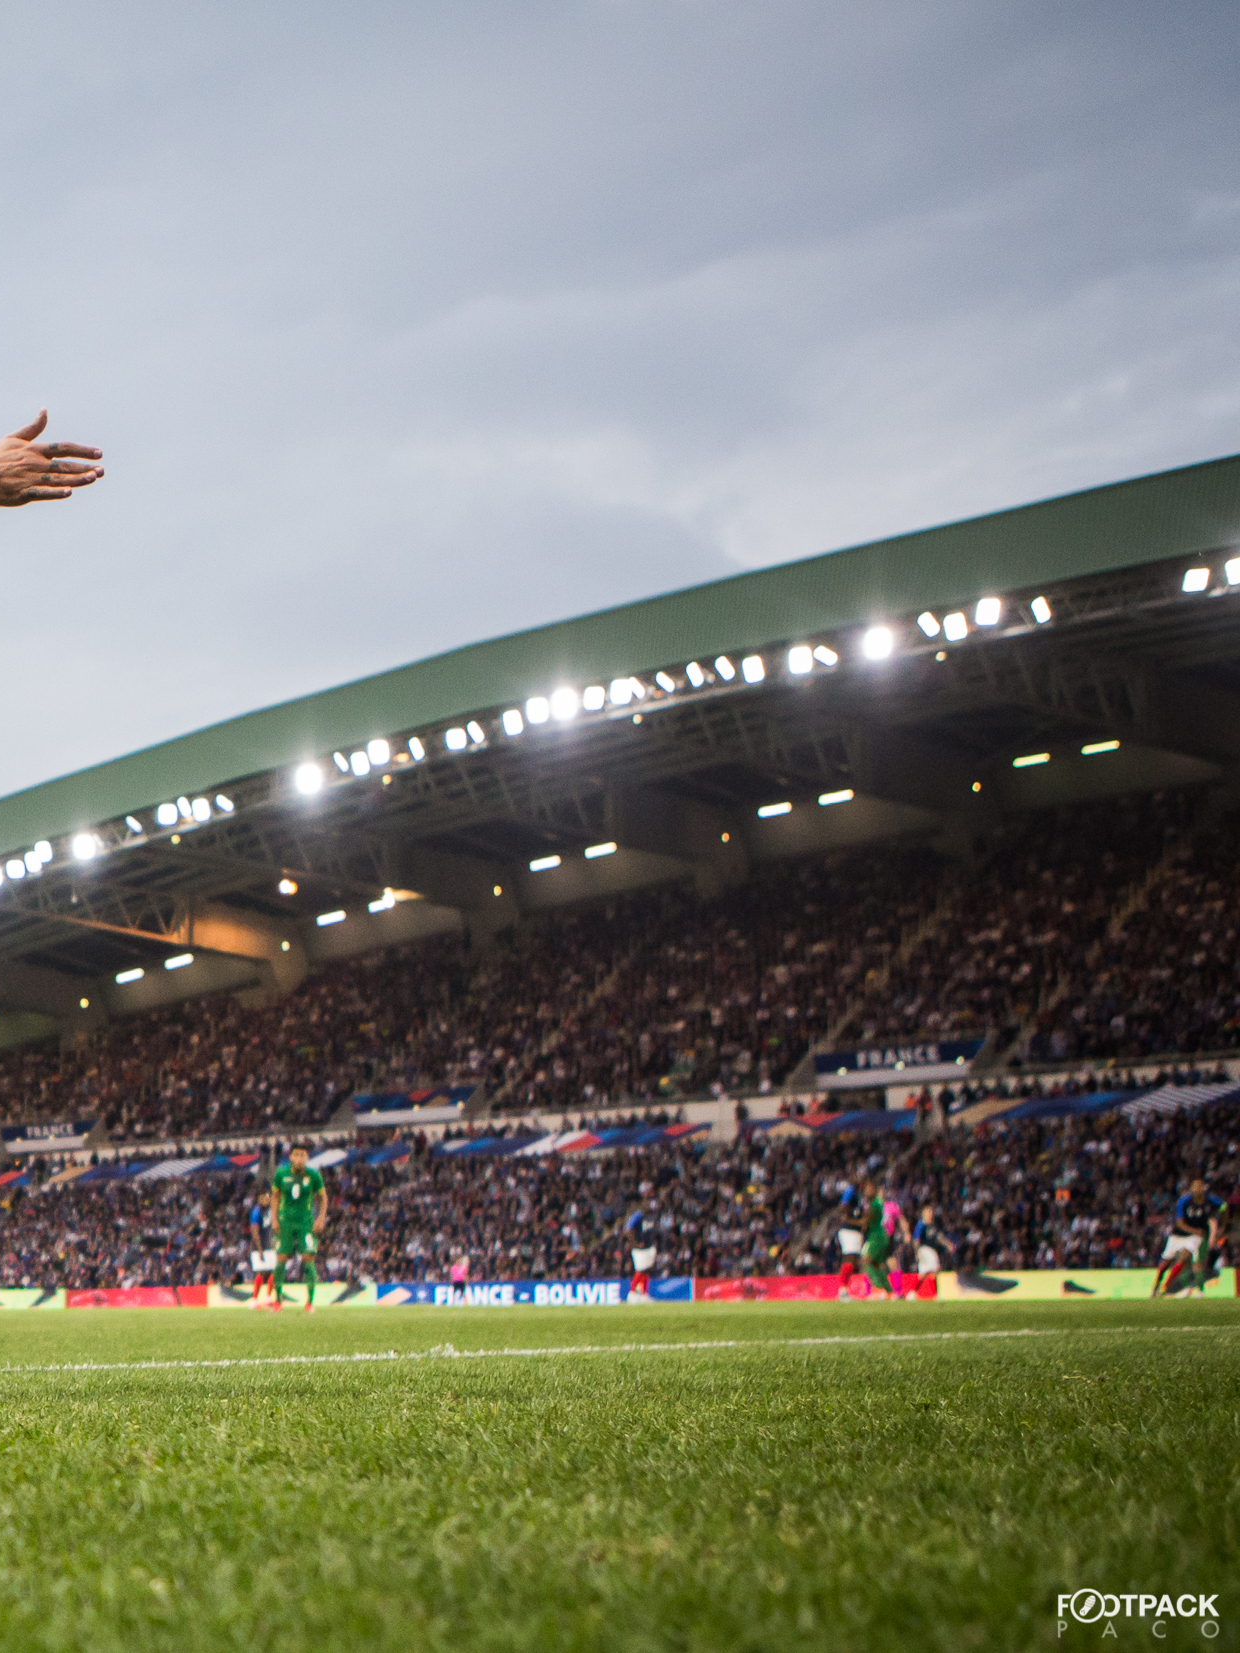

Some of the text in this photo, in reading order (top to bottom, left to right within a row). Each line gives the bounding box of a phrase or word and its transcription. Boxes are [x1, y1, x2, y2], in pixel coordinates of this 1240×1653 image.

[856, 1045, 939, 1069] FRANCE
[26, 1123, 74, 1138] FRANCE
[533, 1282, 621, 1306] BOLIVIE
